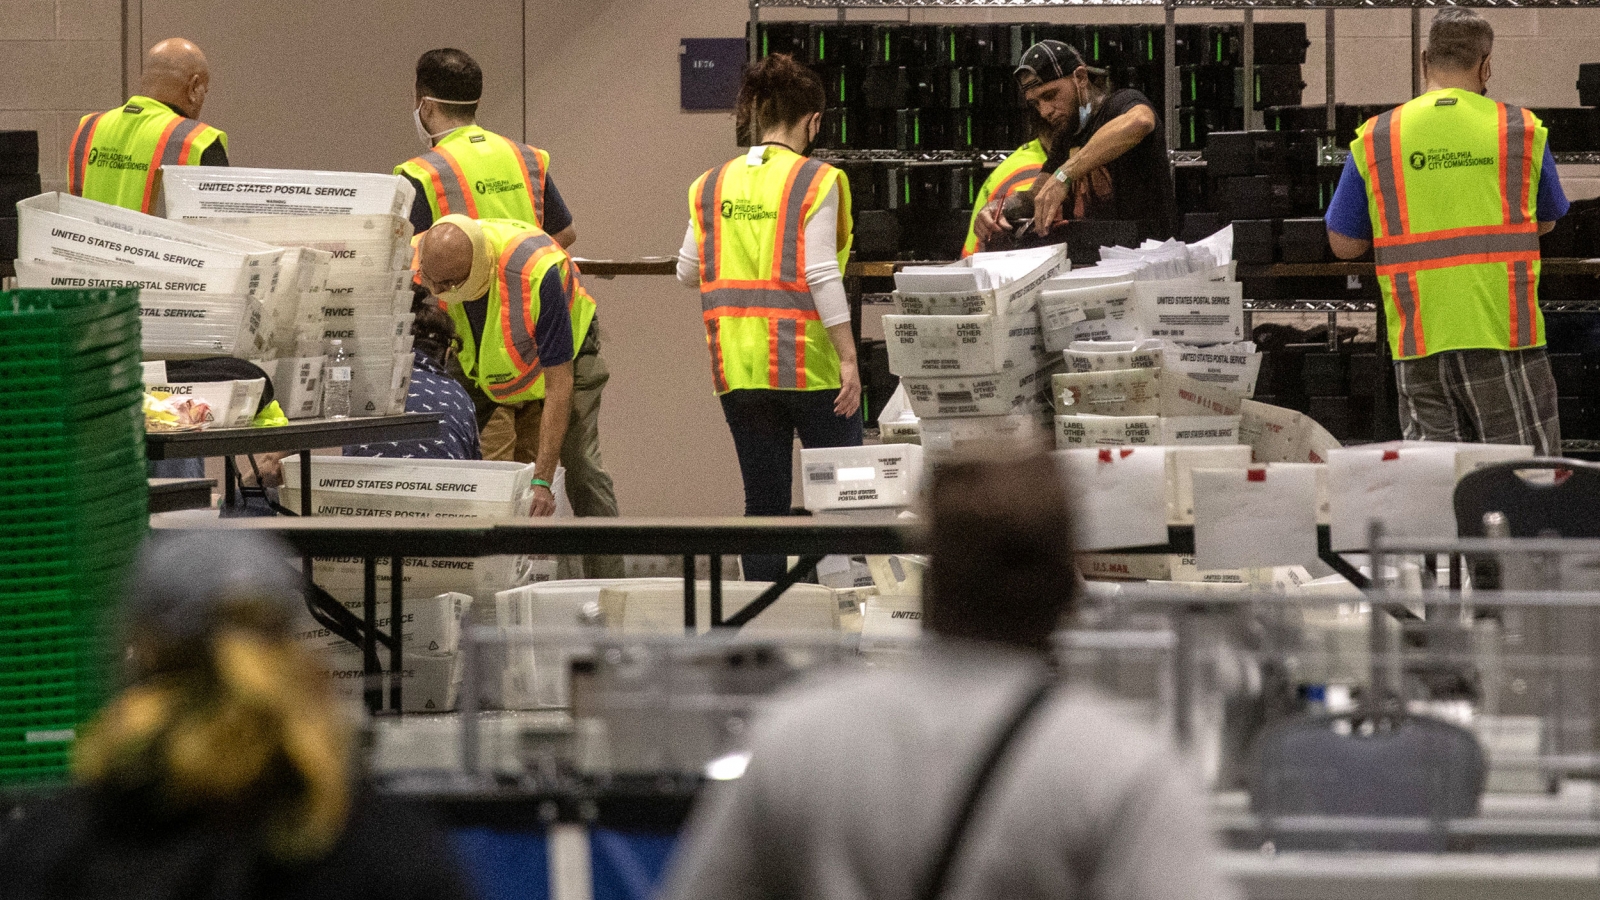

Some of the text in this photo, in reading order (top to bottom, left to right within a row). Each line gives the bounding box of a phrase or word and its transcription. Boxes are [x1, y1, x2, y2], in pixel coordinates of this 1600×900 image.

[1428, 151, 1472, 162] PHILADELPHIA
[1428, 157, 1494, 170] CITY COMMISSIONERS
[198, 182, 357, 197] UNITED STATES POSTAL SERVICE
[51, 228, 86, 244] UNITED
[87, 236, 122, 252] STATES
[124, 245, 160, 260] POSTAL
[162, 253, 205, 268] SERVICE
[331, 250, 356, 259] VICE
[51, 277, 206, 291] UNITED STATES POSTAL SERVICE
[1157, 296, 1230, 305] UNITED STATES POSTAL SERVICE
[138, 308, 206, 318] STAL SERVICE
[1180, 353, 1247, 365] UNITED STATES POSTAL SERVICE
[973, 386, 997, 394] OTHER
[1064, 422, 1085, 430] LABEL
[319, 479, 477, 492] UNITED STATES POSTAL SERVICE
[318, 506, 354, 516] UNITED
[355, 507, 392, 517] STATES
[315, 556, 350, 564] UNITED
[352, 558, 389, 566] STES
[432, 560, 474, 570] SERVICE
[1108, 562, 1129, 574] MAIL
[375, 614, 414, 628] SERCE
[891, 611, 921, 620] UNITED
[301, 629, 330, 640] TATES
[332, 670, 366, 679] POSTA
